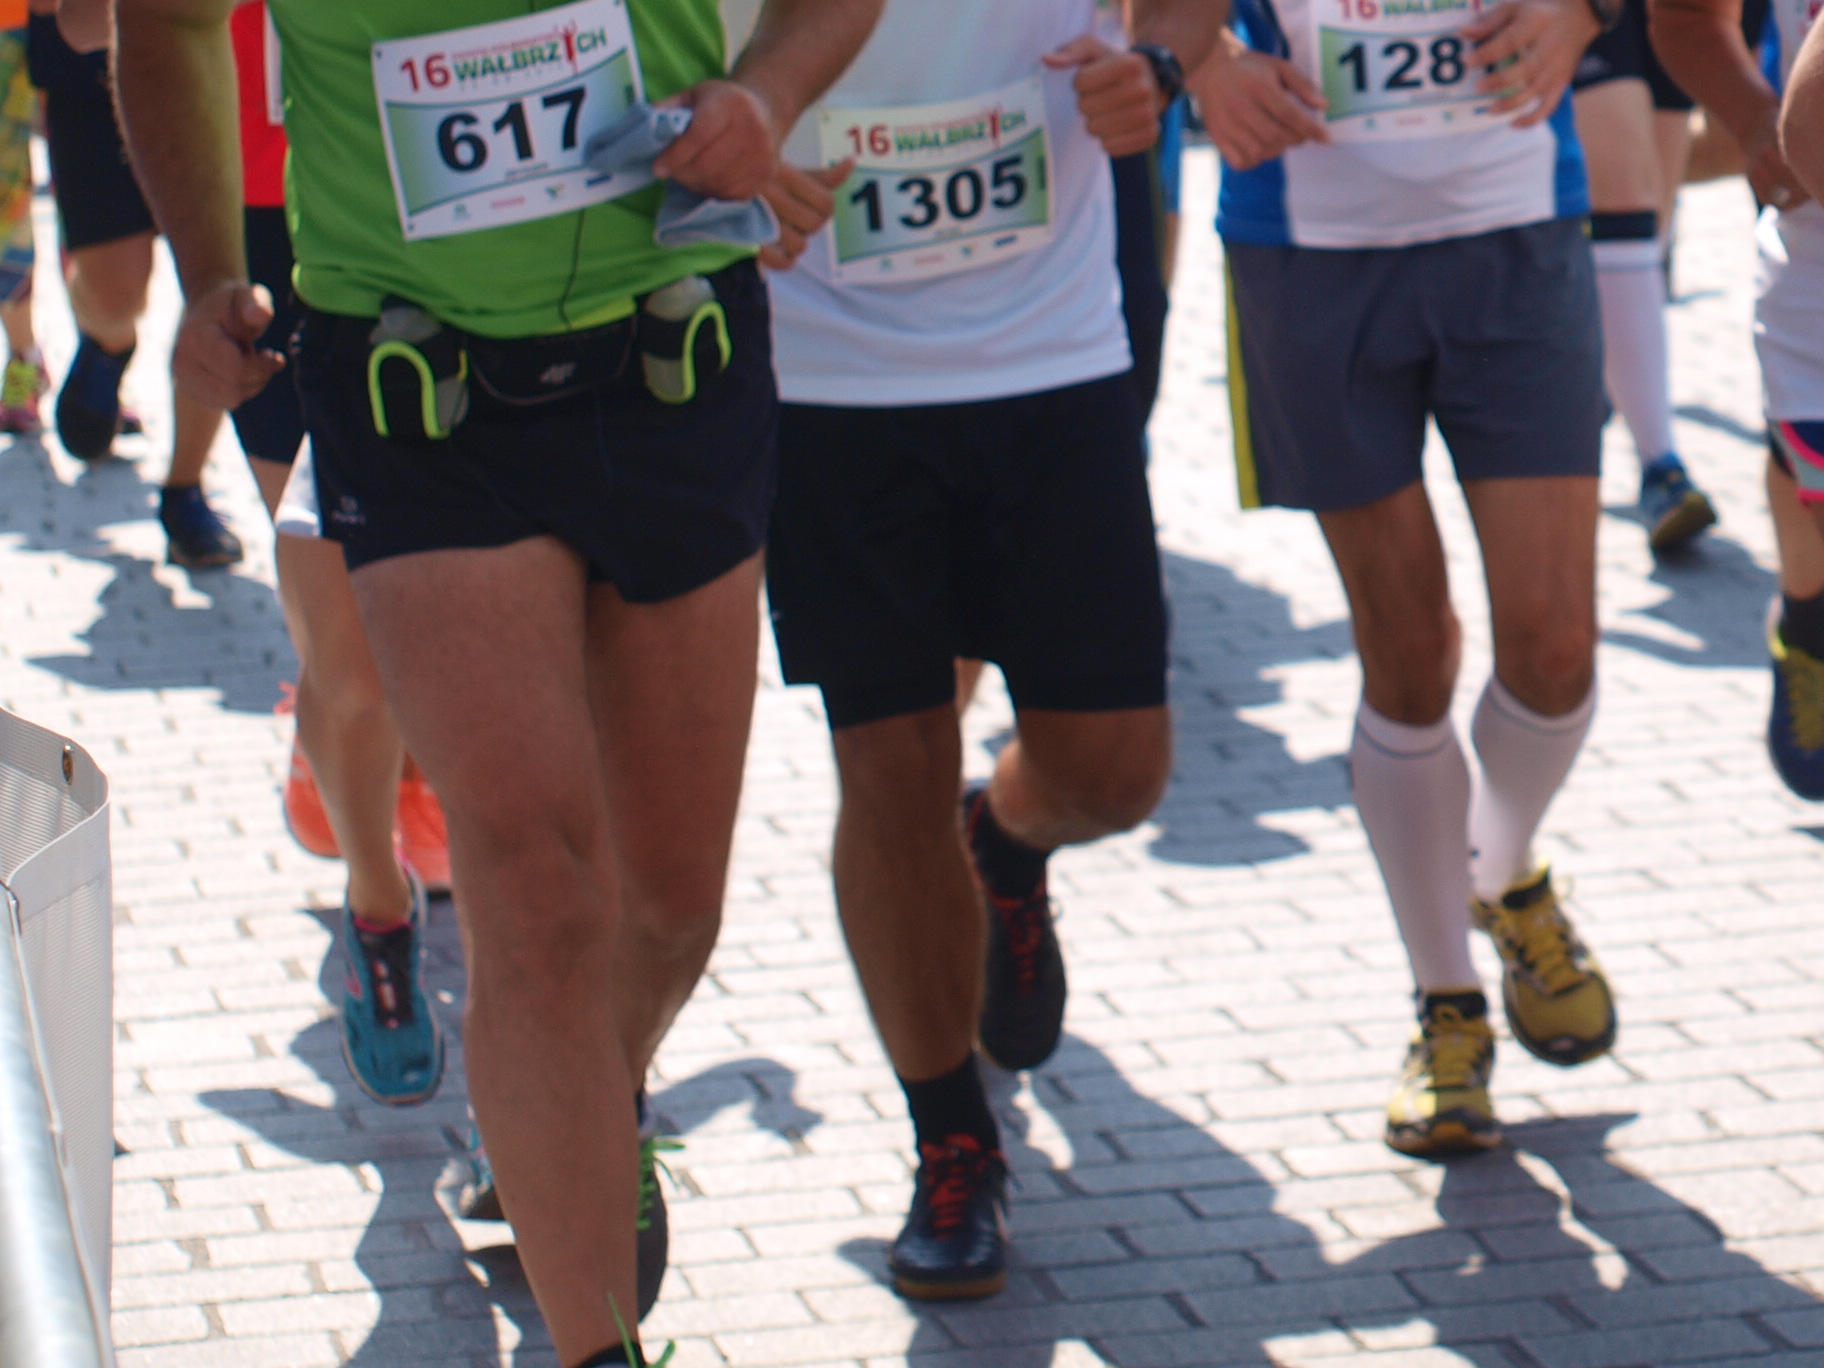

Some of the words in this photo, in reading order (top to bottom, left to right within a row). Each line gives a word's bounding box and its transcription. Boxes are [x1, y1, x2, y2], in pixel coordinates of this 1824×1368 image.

[401, 51, 450, 94] 16
[1337, 33, 1497, 92] 128
[437, 85, 586, 173] 617
[847, 122, 892, 158] 16
[850, 153, 1027, 233] 1305
